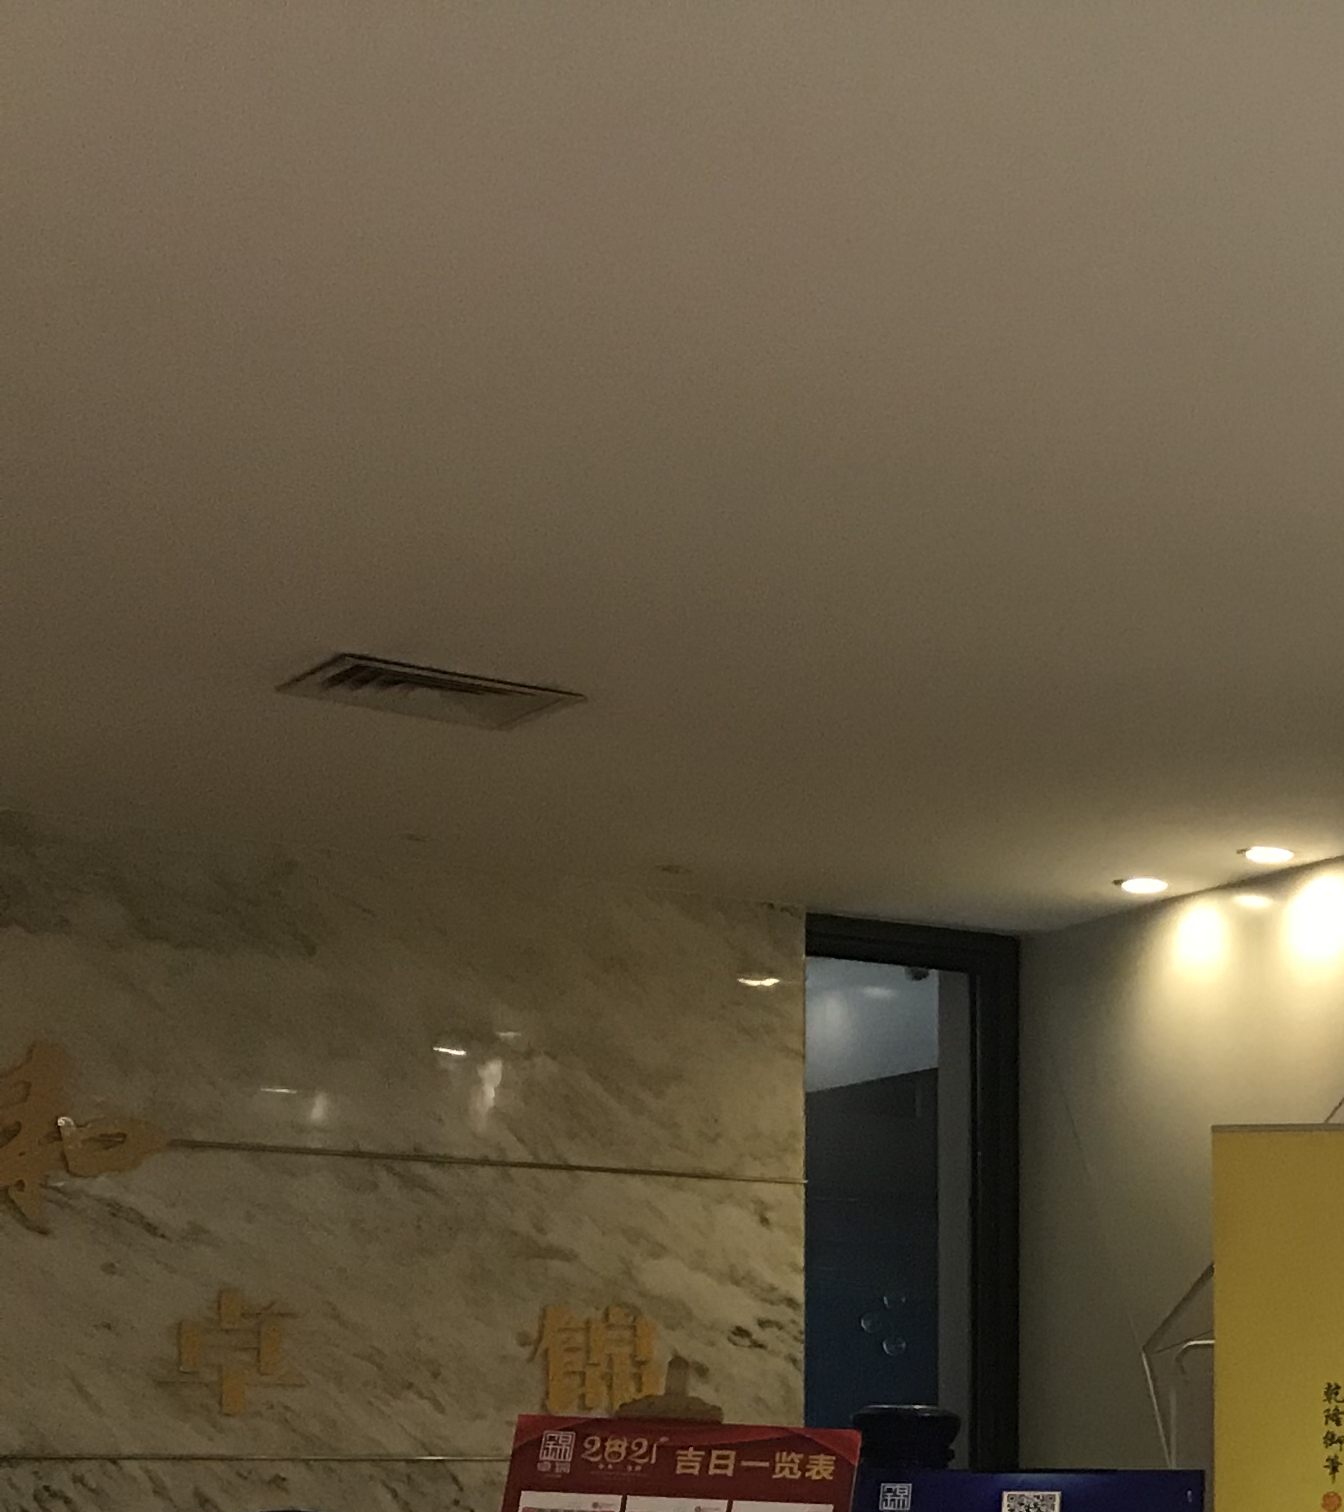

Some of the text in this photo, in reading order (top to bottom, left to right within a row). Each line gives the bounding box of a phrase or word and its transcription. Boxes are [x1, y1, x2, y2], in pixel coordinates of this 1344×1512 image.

[675, 1446, 838, 1482] 吉日一览表
